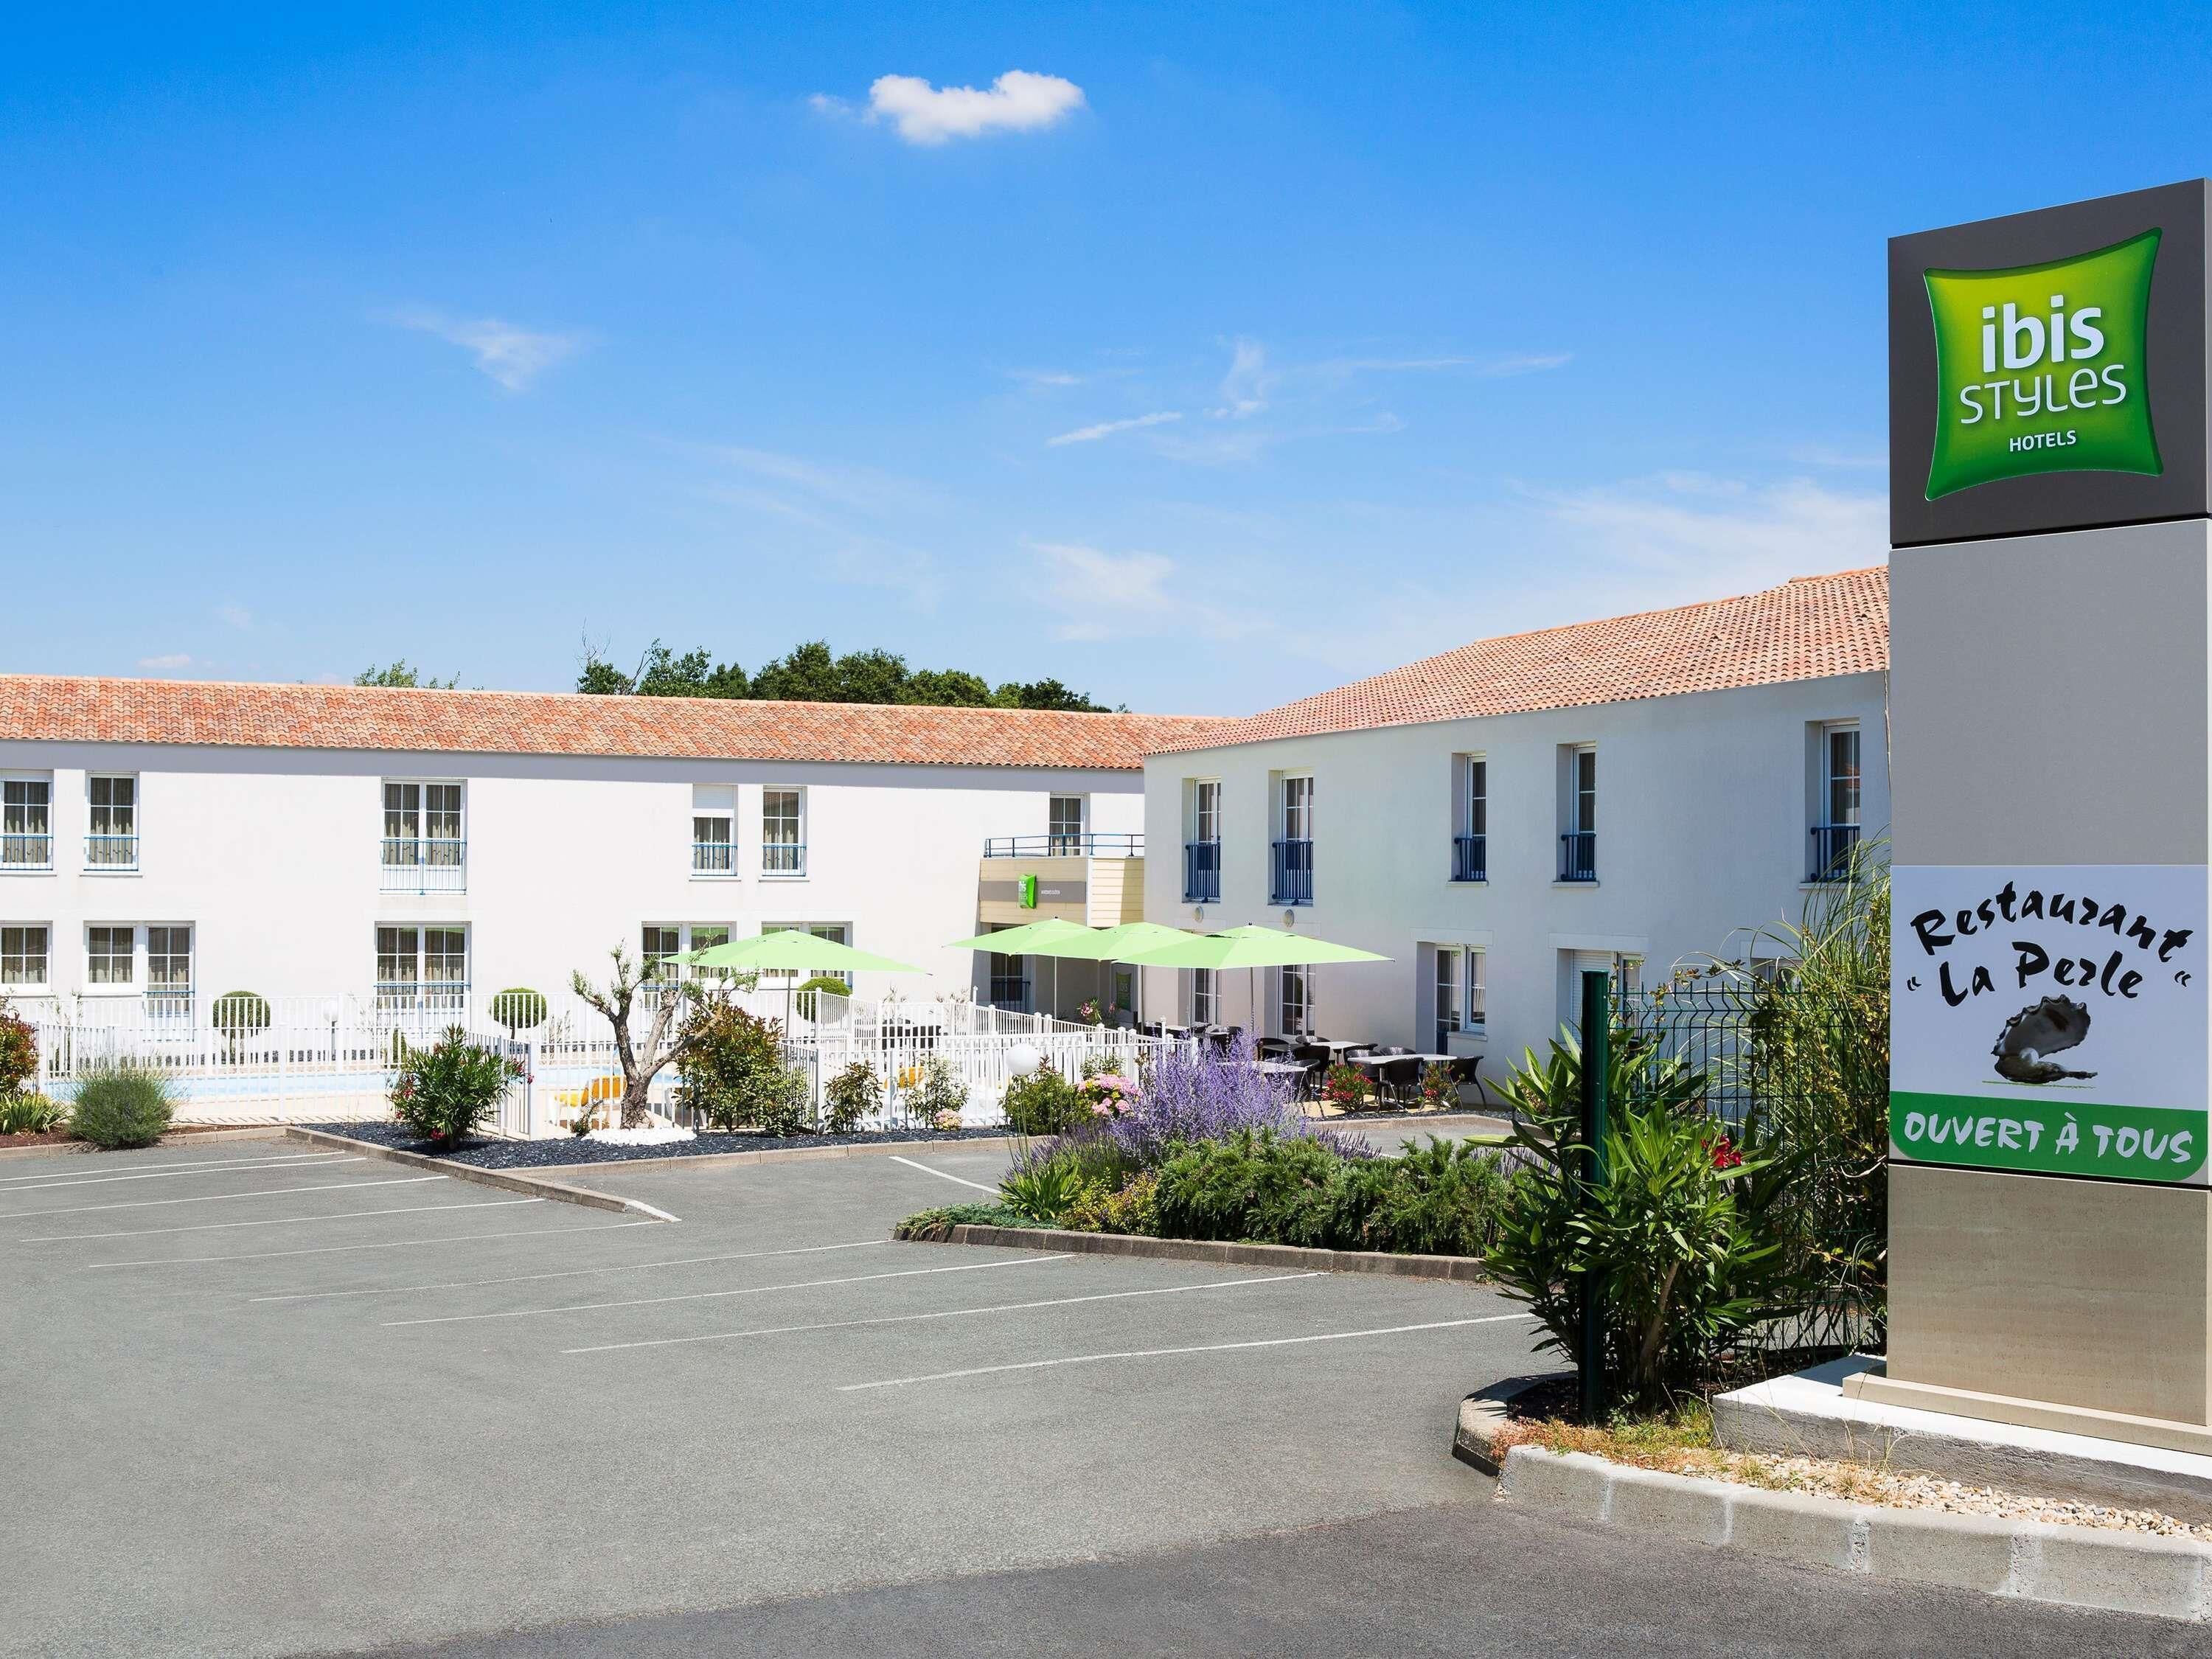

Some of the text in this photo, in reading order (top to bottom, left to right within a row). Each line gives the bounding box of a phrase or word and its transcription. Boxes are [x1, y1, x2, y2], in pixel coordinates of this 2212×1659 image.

[1982, 295, 2104, 372] ibis
[2009, 430, 2076, 452] HOTELS
[1910, 880, 2194, 963] Restaurant
[1904, 1112, 2194, 1164] OUVERT À TOUS
